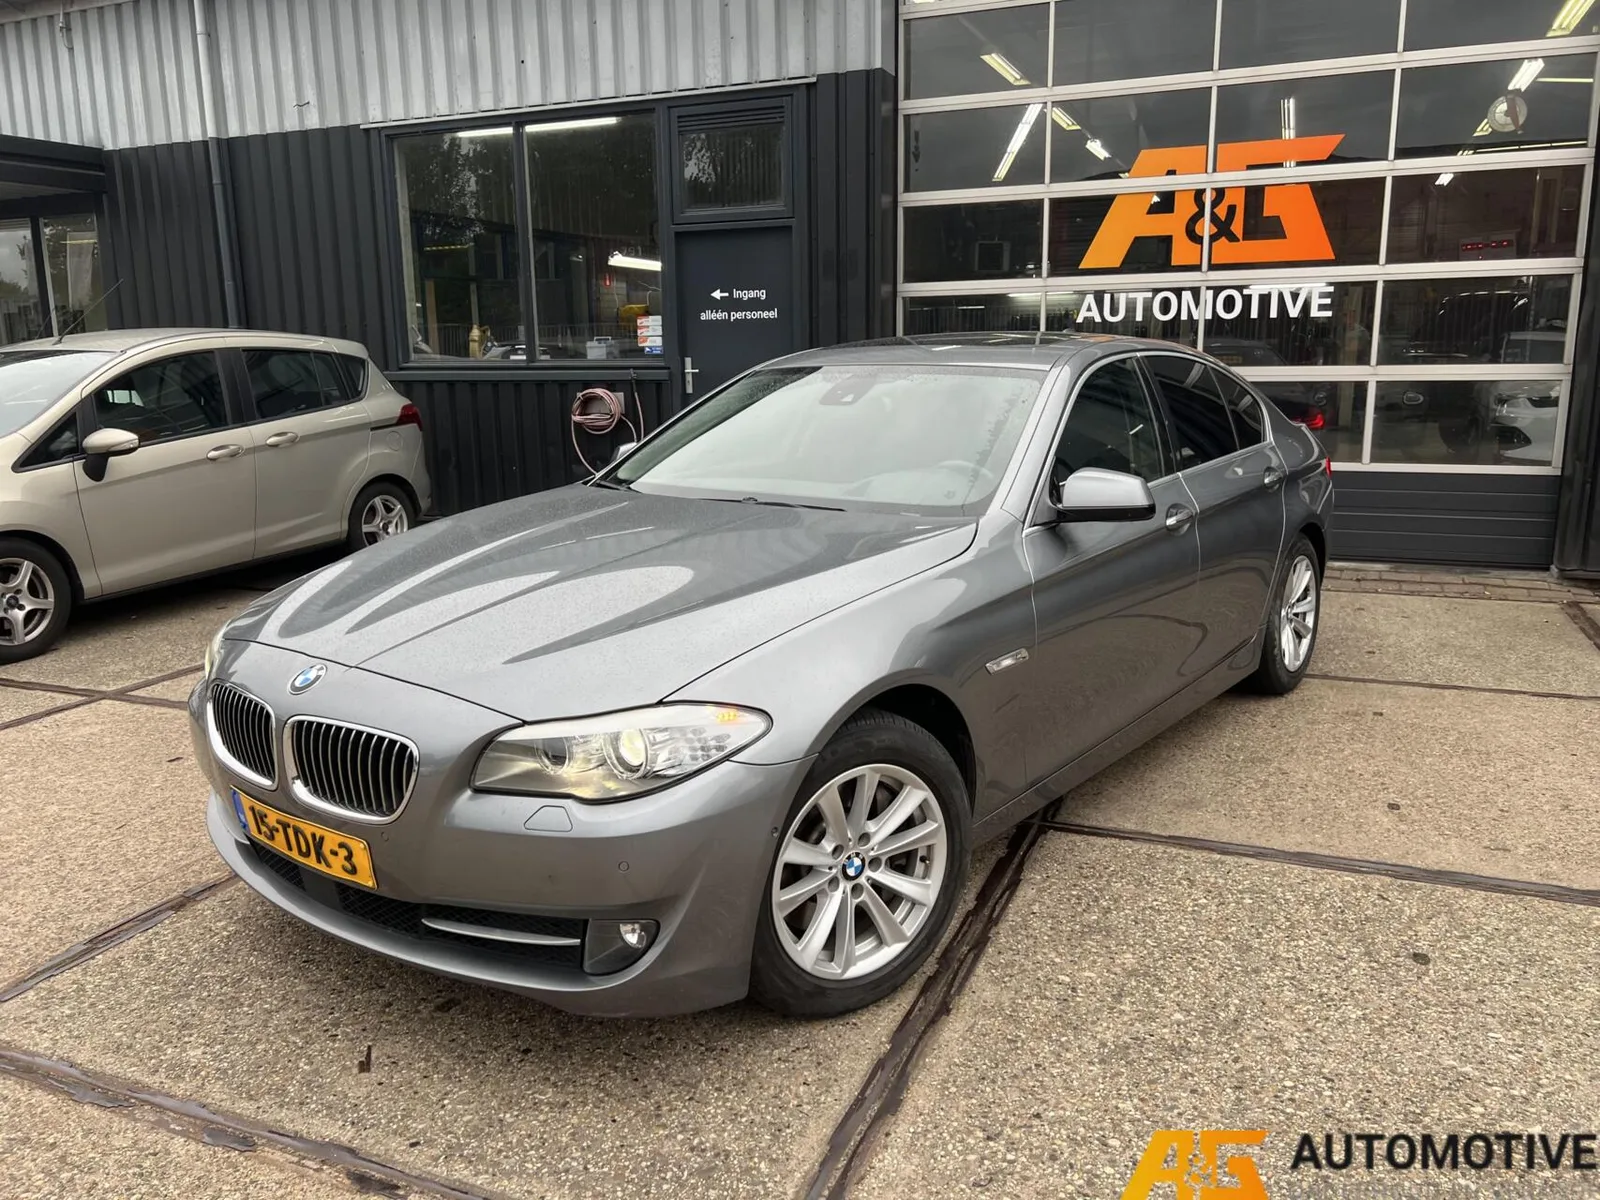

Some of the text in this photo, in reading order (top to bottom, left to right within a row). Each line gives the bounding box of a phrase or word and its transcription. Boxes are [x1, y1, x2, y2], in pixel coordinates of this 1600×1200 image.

[1078, 134, 1346, 269] A&G
[733, 288, 766, 300] Ingang
[1075, 286, 1335, 324] AUTOMOTIVE
[700, 308, 778, 322] alléén personeel
[249, 805, 357, 875] 15-TDK-3
